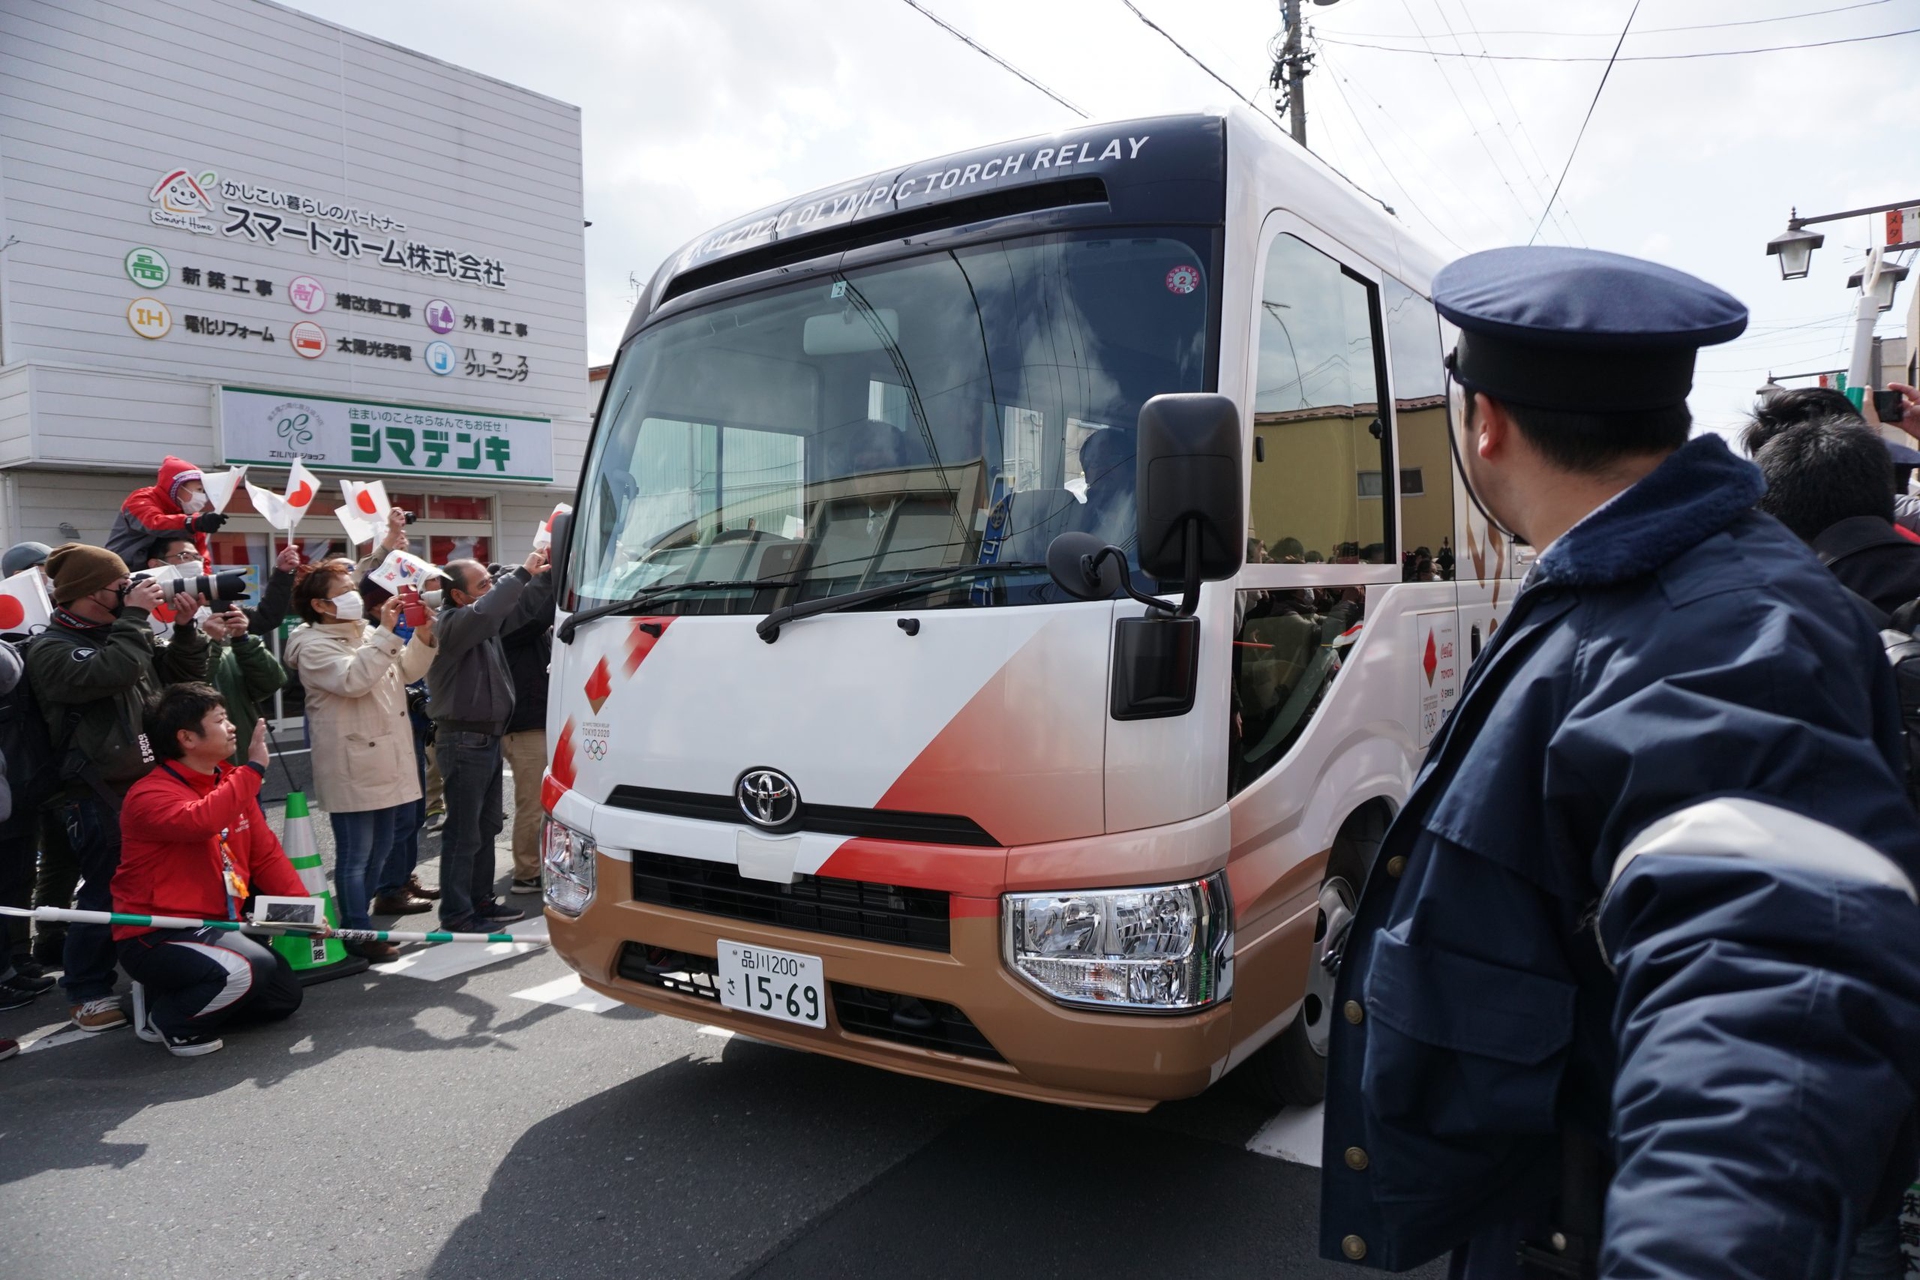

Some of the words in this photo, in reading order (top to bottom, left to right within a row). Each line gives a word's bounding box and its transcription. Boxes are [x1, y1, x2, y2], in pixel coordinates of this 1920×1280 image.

[732, 211, 793, 245] 2020
[796, 179, 916, 230] OLYMPIC
[925, 153, 1022, 196] TORCH
[1032, 135, 1150, 170] RELAY
[224, 181, 406, 232] かしこい暮らしのパートナー
[154, 211, 185, 226] Smart
[189, 217, 213, 232] Home
[225, 204, 507, 288] スマートホーム株式会社
[182, 266, 273, 297] 新築工事
[1179, 276, 1187, 285] 2
[136, 307, 164, 328] IH
[336, 292, 412, 320] 増改築工事
[185, 315, 275, 342] 電化リフォーム
[464, 314, 529, 338] 外構工事
[337, 337, 412, 362] 太陽光発電
[464, 347, 529, 368] ハウス
[465, 363, 529, 383] クリーニング
[348, 407, 508, 433] 住まいのことならなんでもお任せ！
[350, 423, 510, 472] シマデンキ
[582, 727, 597, 738] TOKYO
[597, 729, 610, 739] 2020
[727, 978, 735, 996] さ
[744, 973, 819, 1021] 15-69
